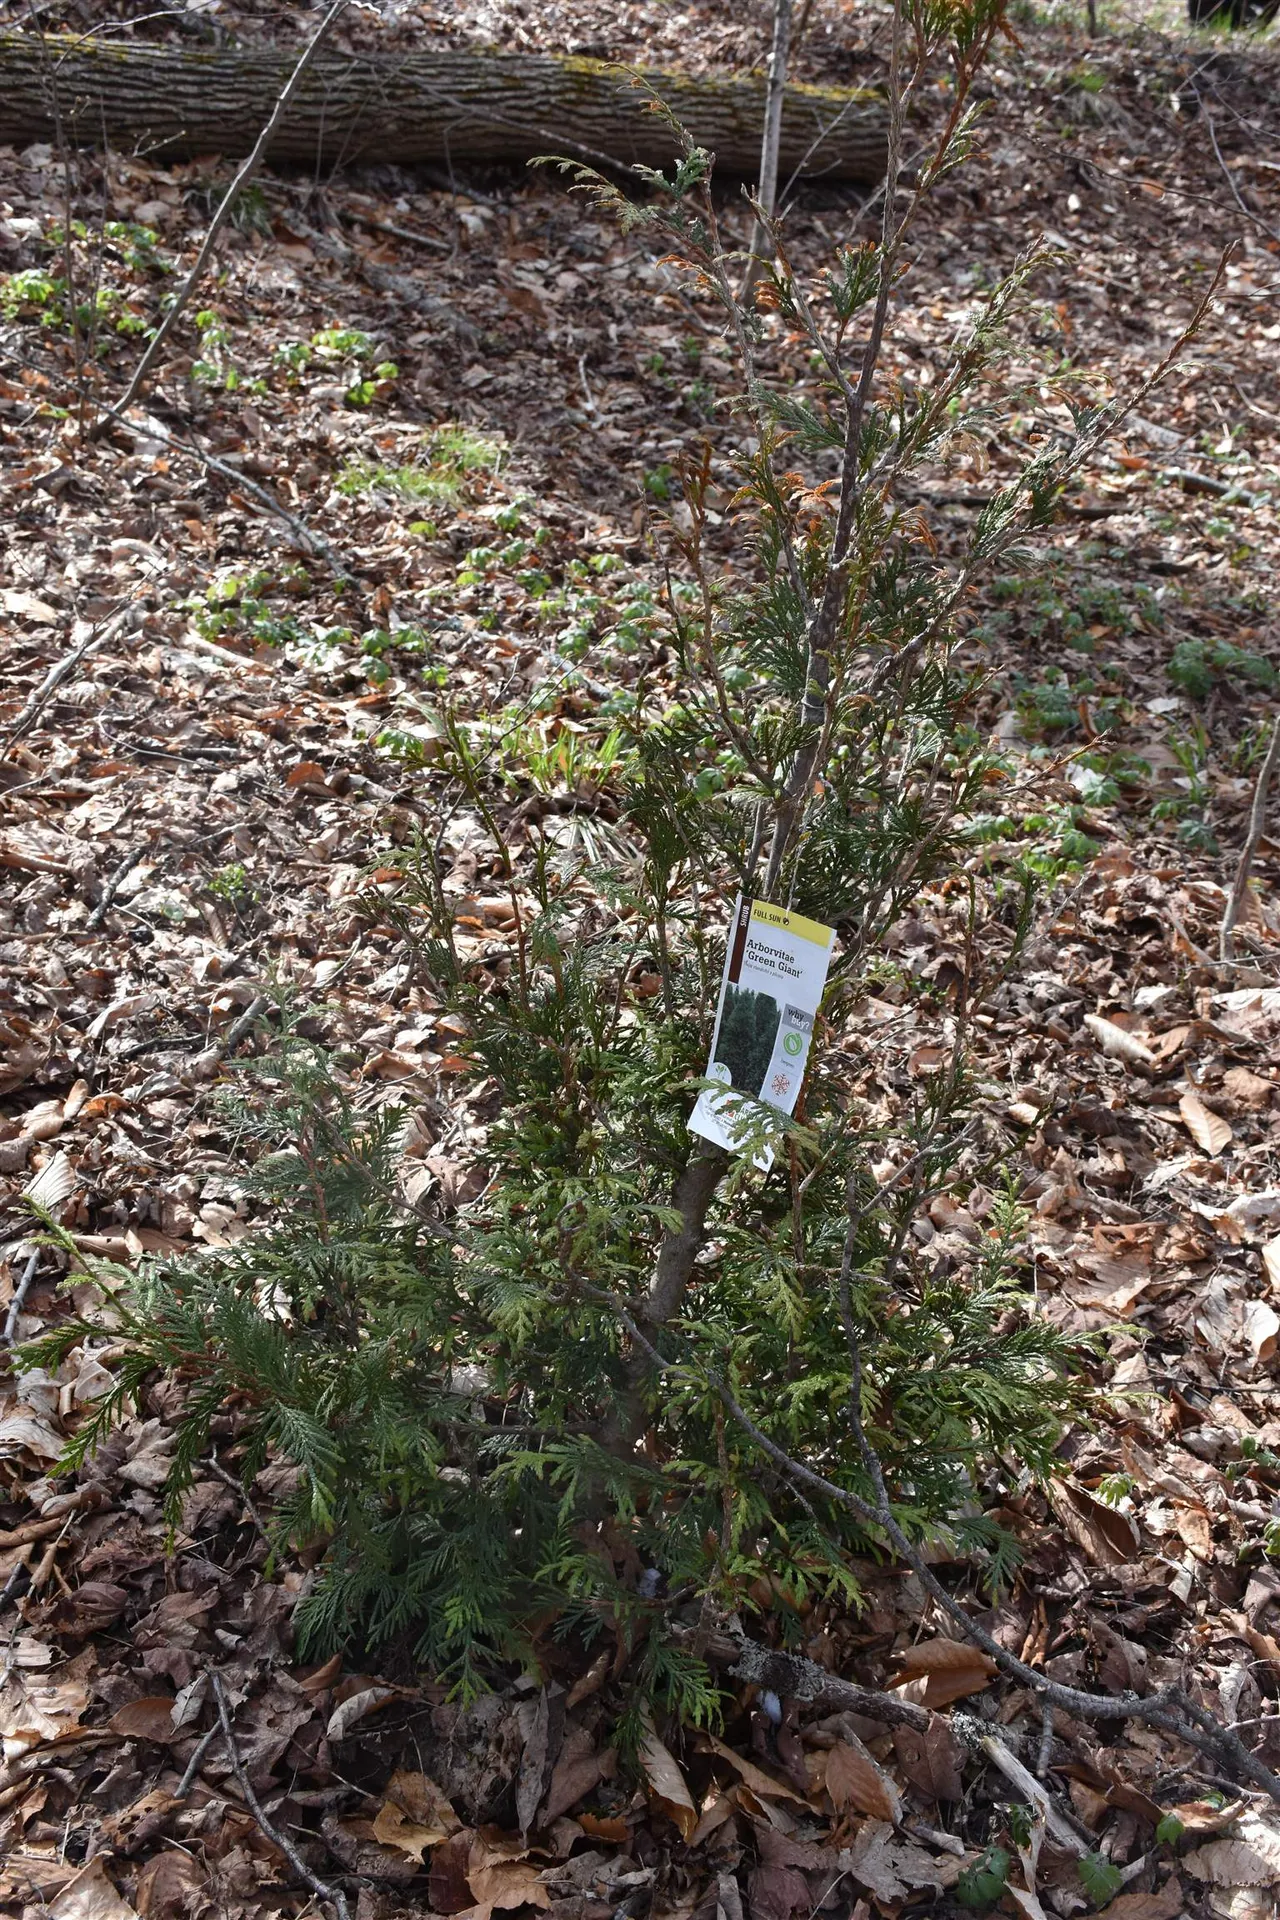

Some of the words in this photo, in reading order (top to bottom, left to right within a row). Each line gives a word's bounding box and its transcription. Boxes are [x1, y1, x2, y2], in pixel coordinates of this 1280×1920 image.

[740, 905, 750, 927] SHRUB
[753, 908, 768, 920] FULL
[769, 913, 782, 924] SUN
[746, 939, 795, 964] Arborvitae
[745, 949, 776, 968] 'Green
[778, 961, 803, 979] Giant'
[788, 1009, 805, 1022] why
[791, 1016, 810, 1030] buy?
